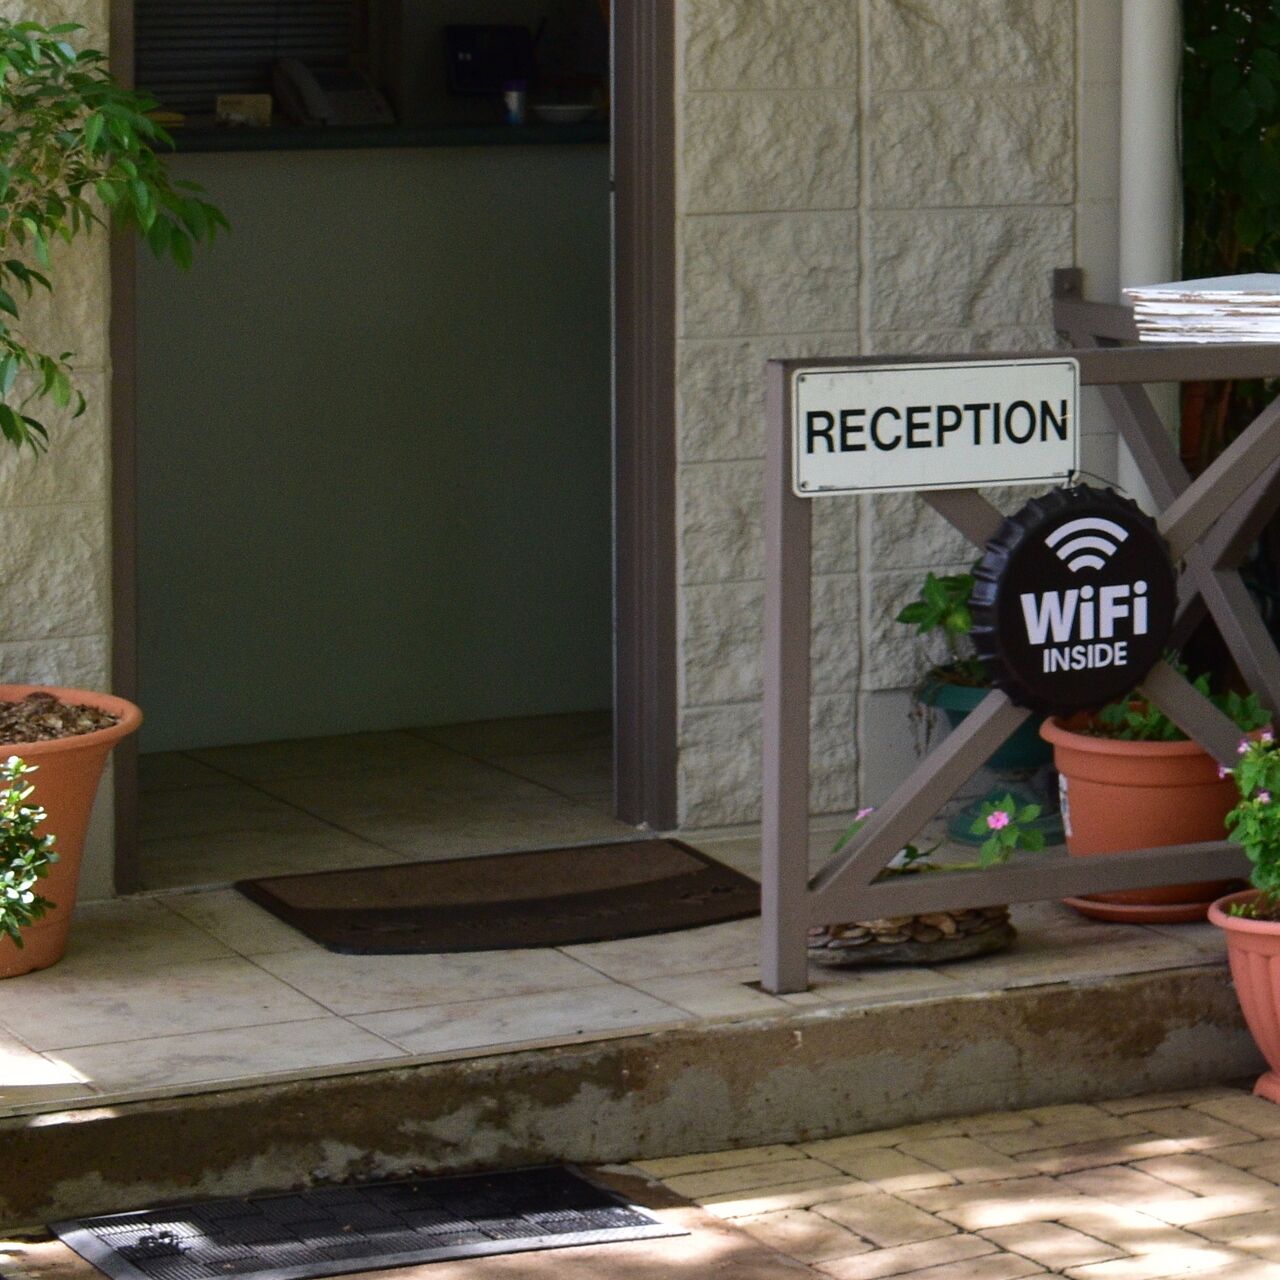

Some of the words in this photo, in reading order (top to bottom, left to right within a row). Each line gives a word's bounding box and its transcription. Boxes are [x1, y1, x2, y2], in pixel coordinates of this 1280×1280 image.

[806, 399, 1069, 454] RECEPTION
[1020, 580, 1149, 646] WiFi
[1042, 641, 1128, 674] INSIDE
